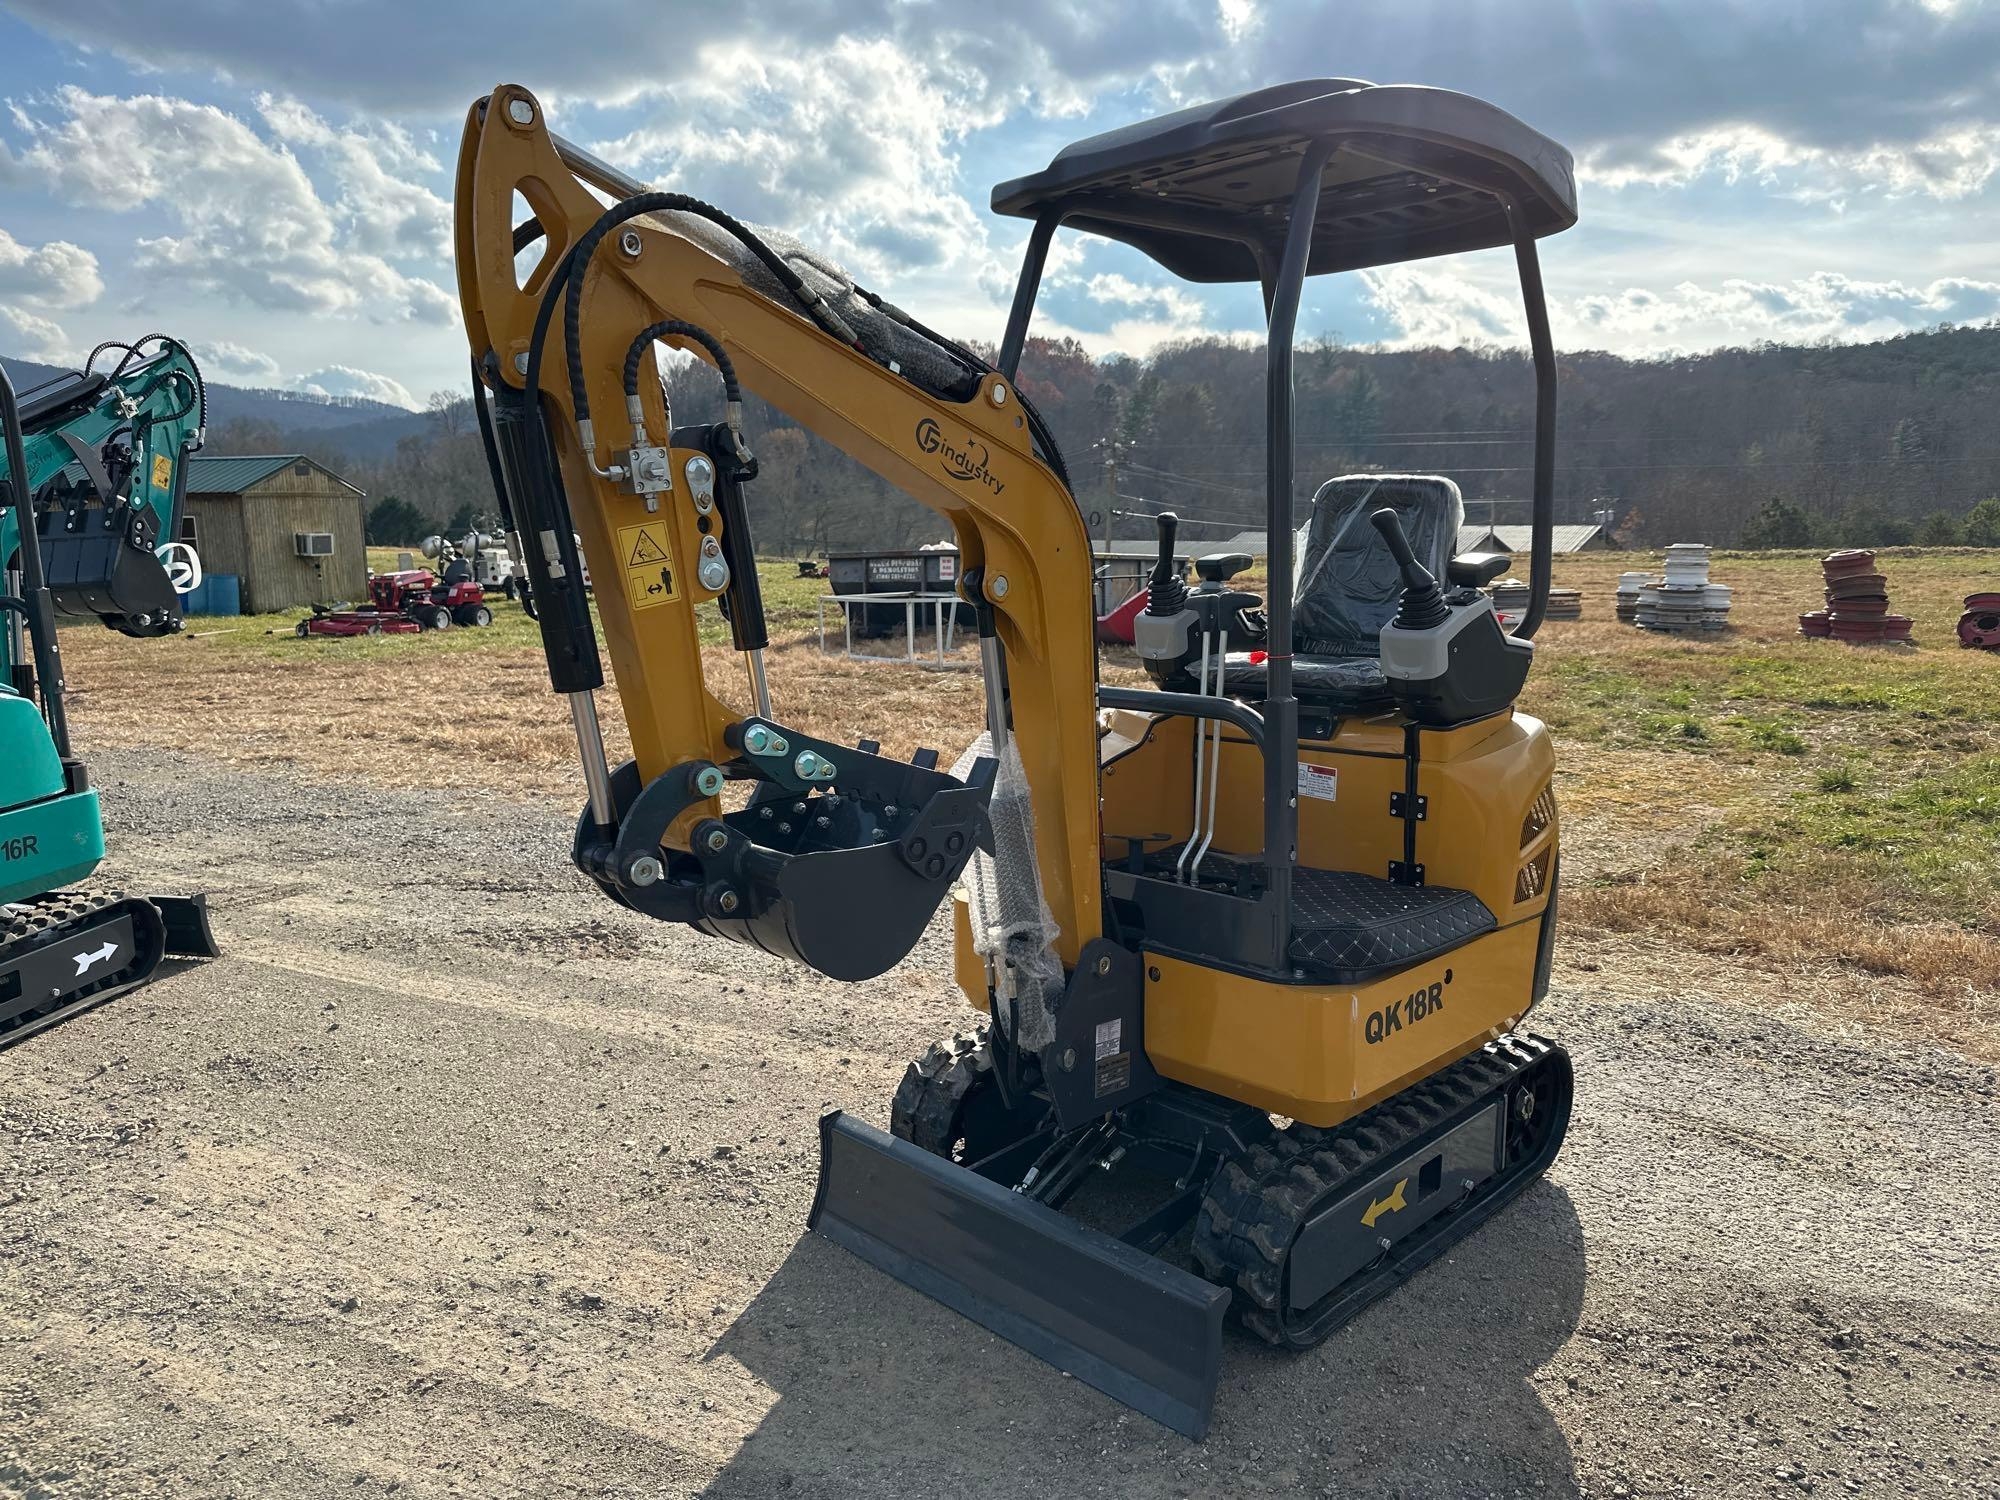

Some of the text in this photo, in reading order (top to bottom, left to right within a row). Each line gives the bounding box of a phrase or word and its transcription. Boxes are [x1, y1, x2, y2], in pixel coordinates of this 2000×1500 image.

[0, 835, 40, 862] 16R
[1365, 982, 1444, 1044] QK 18R
